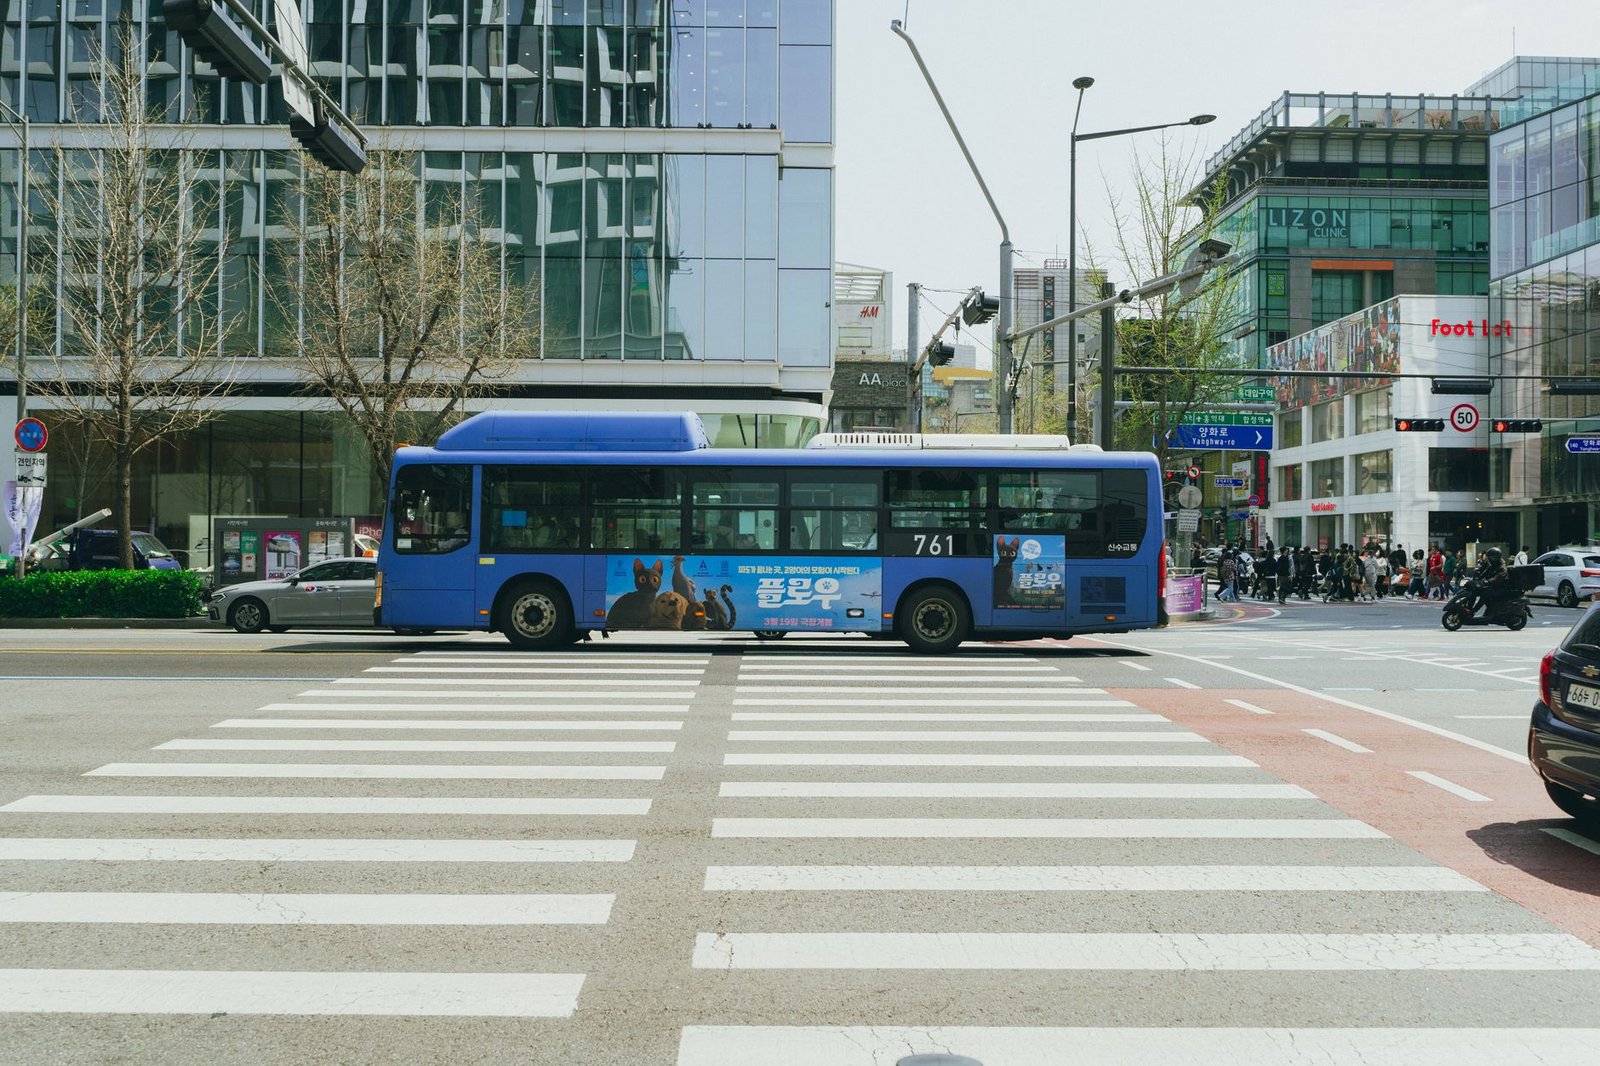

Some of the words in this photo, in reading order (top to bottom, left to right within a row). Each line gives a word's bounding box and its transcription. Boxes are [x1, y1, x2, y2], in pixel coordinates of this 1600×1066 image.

[1269, 209, 1346, 227] LIZON
[1314, 228, 1347, 238] CLINIC
[1431, 319, 1475, 336] Foot
[1457, 412, 1473, 425] 50
[1199, 427, 1229, 437] 양화로
[1192, 437, 1236, 447] Yanghwa-ro
[18, 457, 45, 467] 견인지역
[914, 534, 953, 556] 761
[1107, 543, 1138, 552] 신수교통
[755, 577, 842, 610] 플로우
